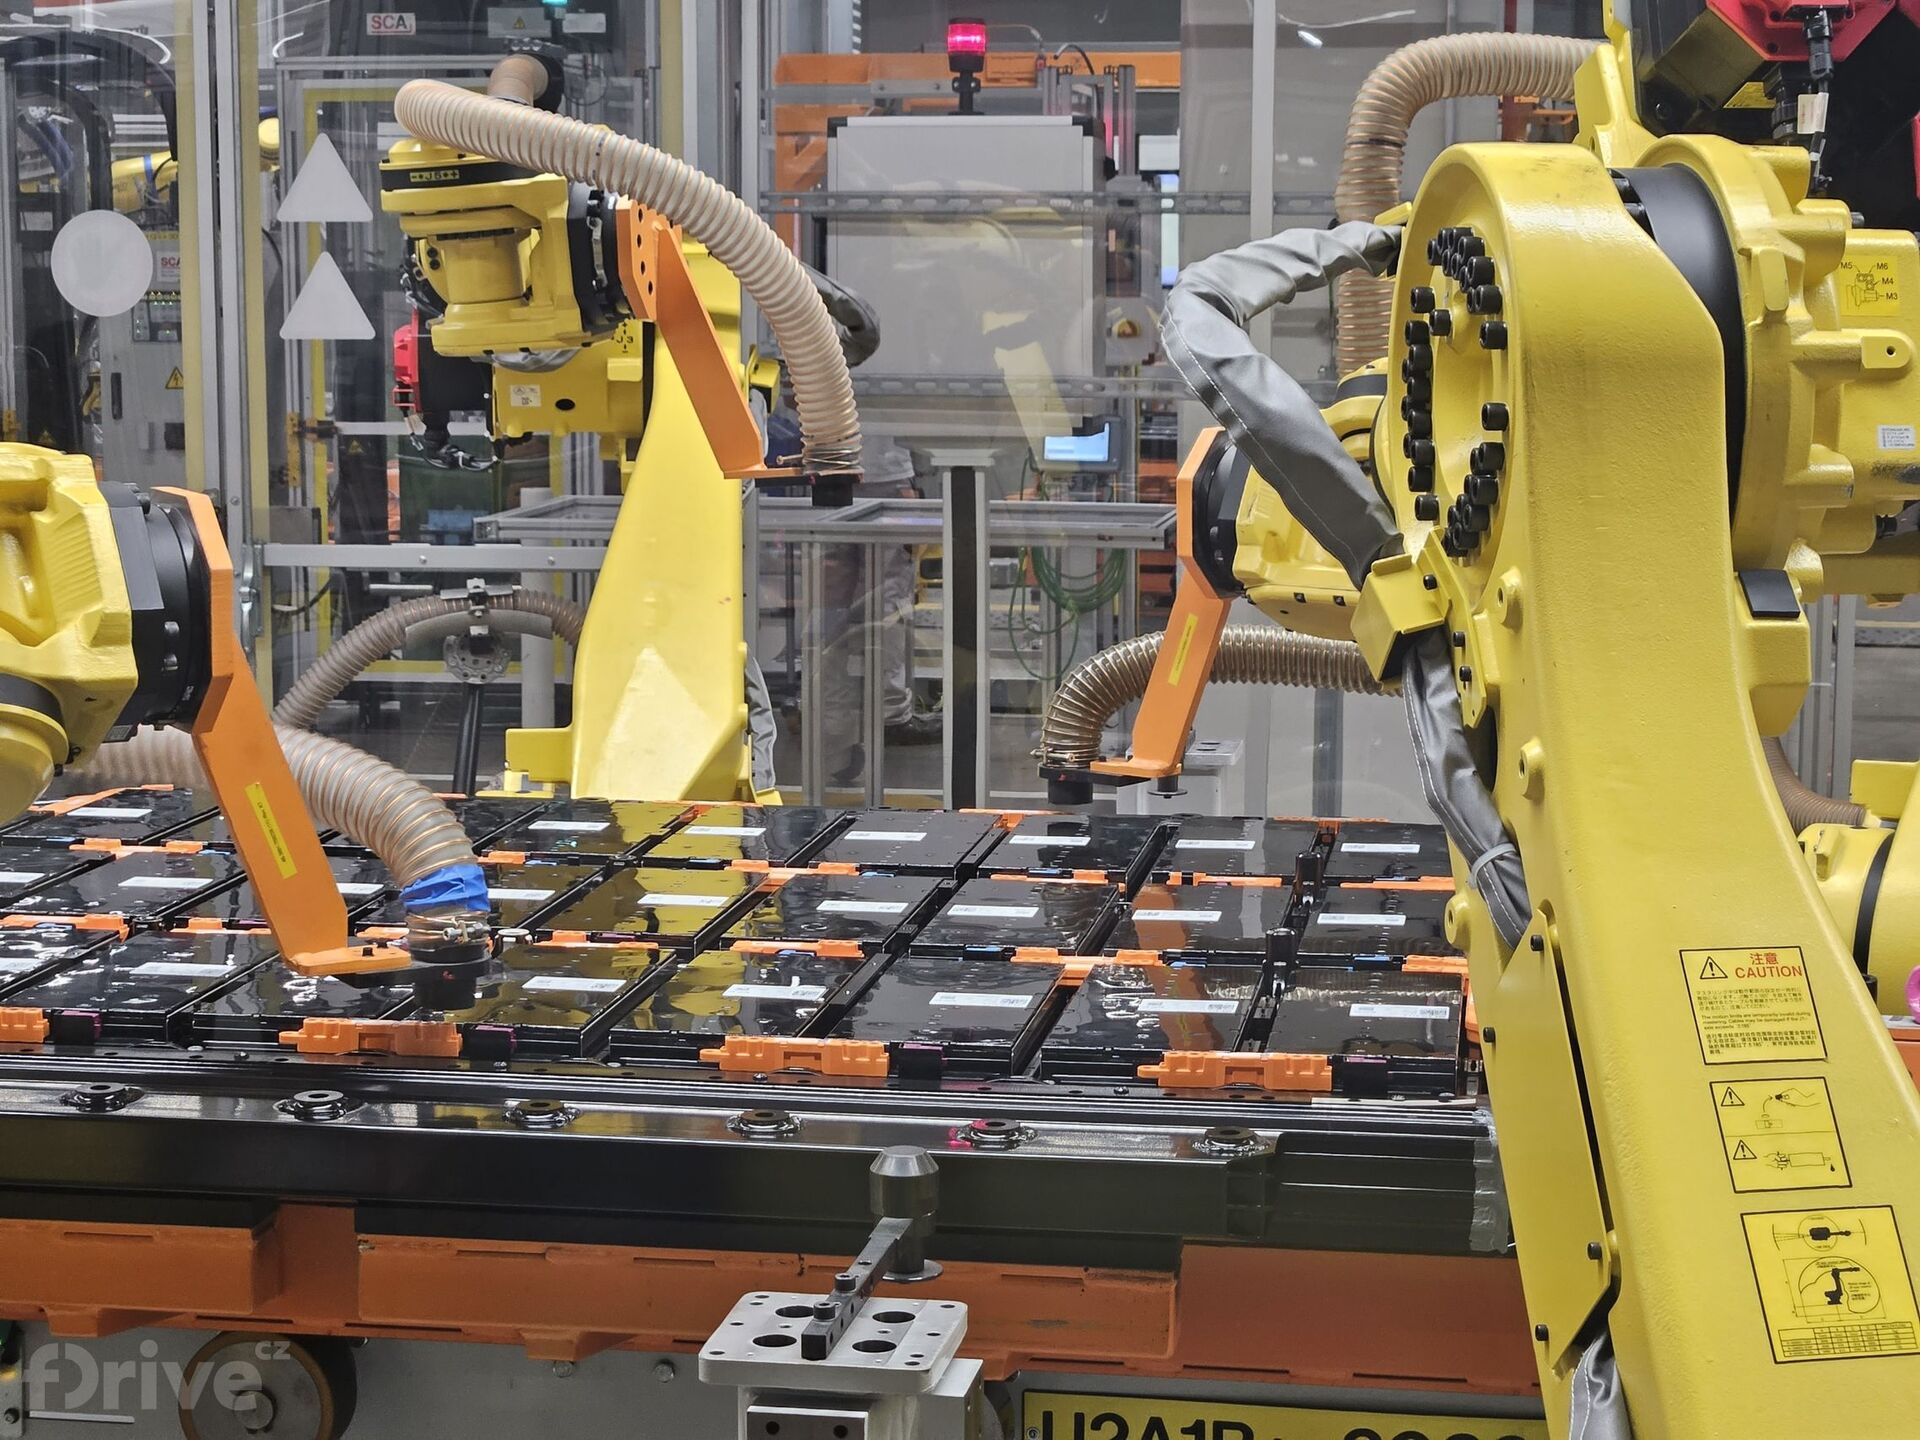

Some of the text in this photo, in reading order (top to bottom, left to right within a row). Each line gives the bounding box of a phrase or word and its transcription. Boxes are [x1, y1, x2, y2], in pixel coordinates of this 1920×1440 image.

[371, 15, 407, 29] SCA
[1840, 262, 1853, 270] M5
[1876, 262, 1889, 270] M6
[1750, 952, 1779, 965] 注意
[1735, 965, 1803, 979] CAUTION
